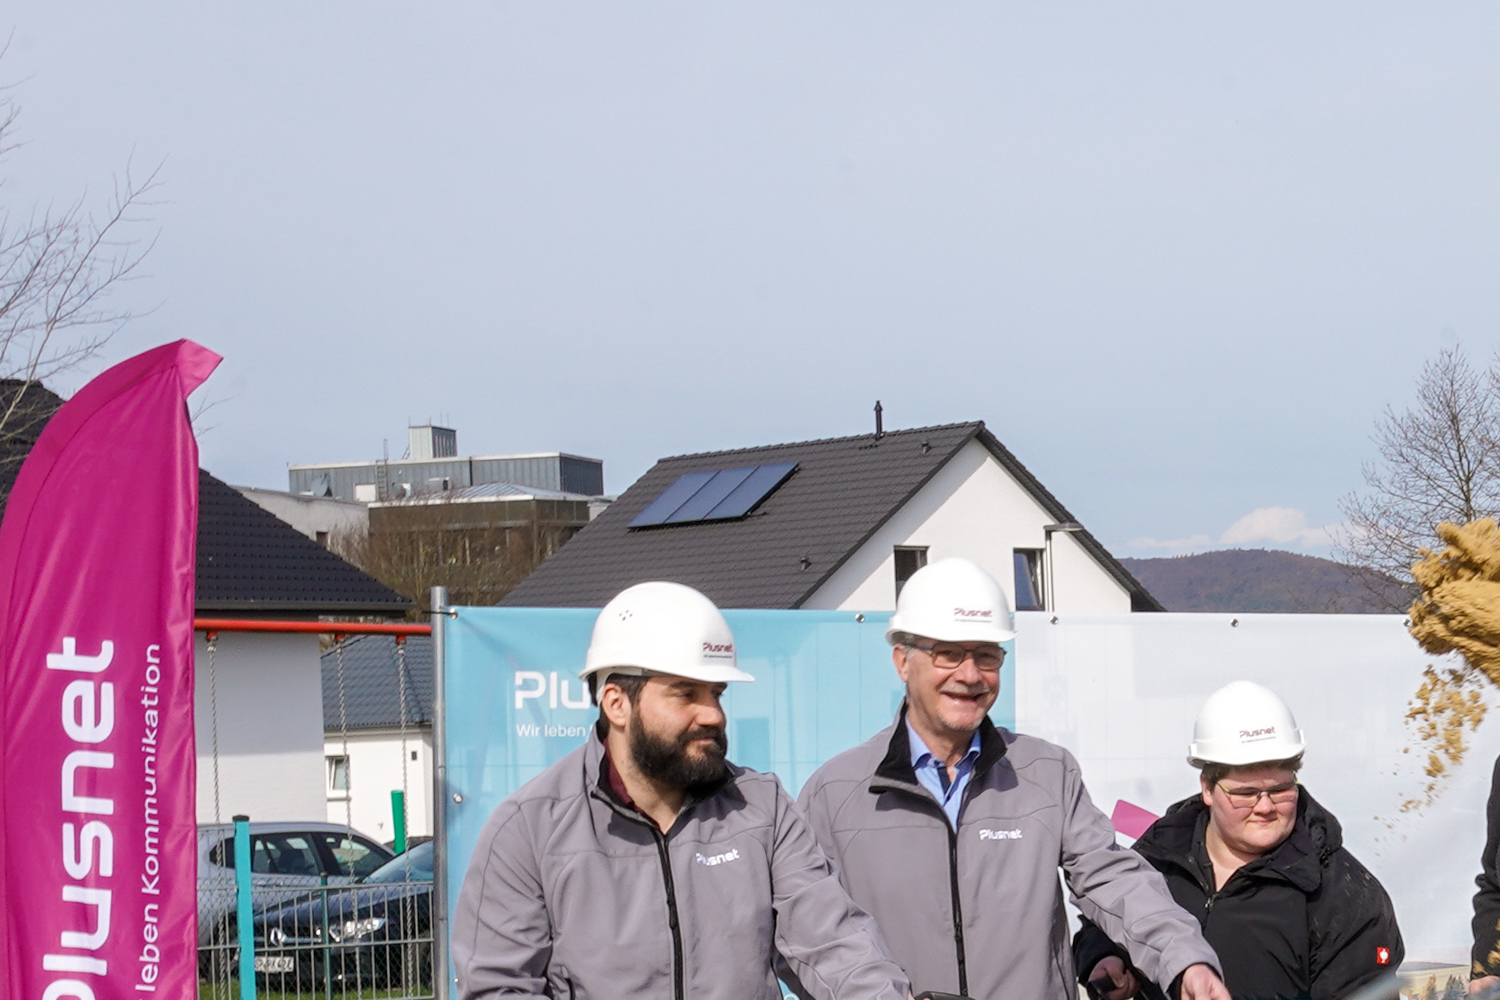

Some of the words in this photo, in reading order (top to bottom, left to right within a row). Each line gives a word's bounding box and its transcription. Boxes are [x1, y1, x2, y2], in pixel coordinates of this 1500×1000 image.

[516, 723, 540, 738] Wir
[543, 723, 587, 738] leben
[1239, 726, 1276, 738] Plusnet
[140, 643, 162, 895] Kommunikation
[979, 828, 1023, 841] Plusnet
[135, 903, 161, 992] leben
